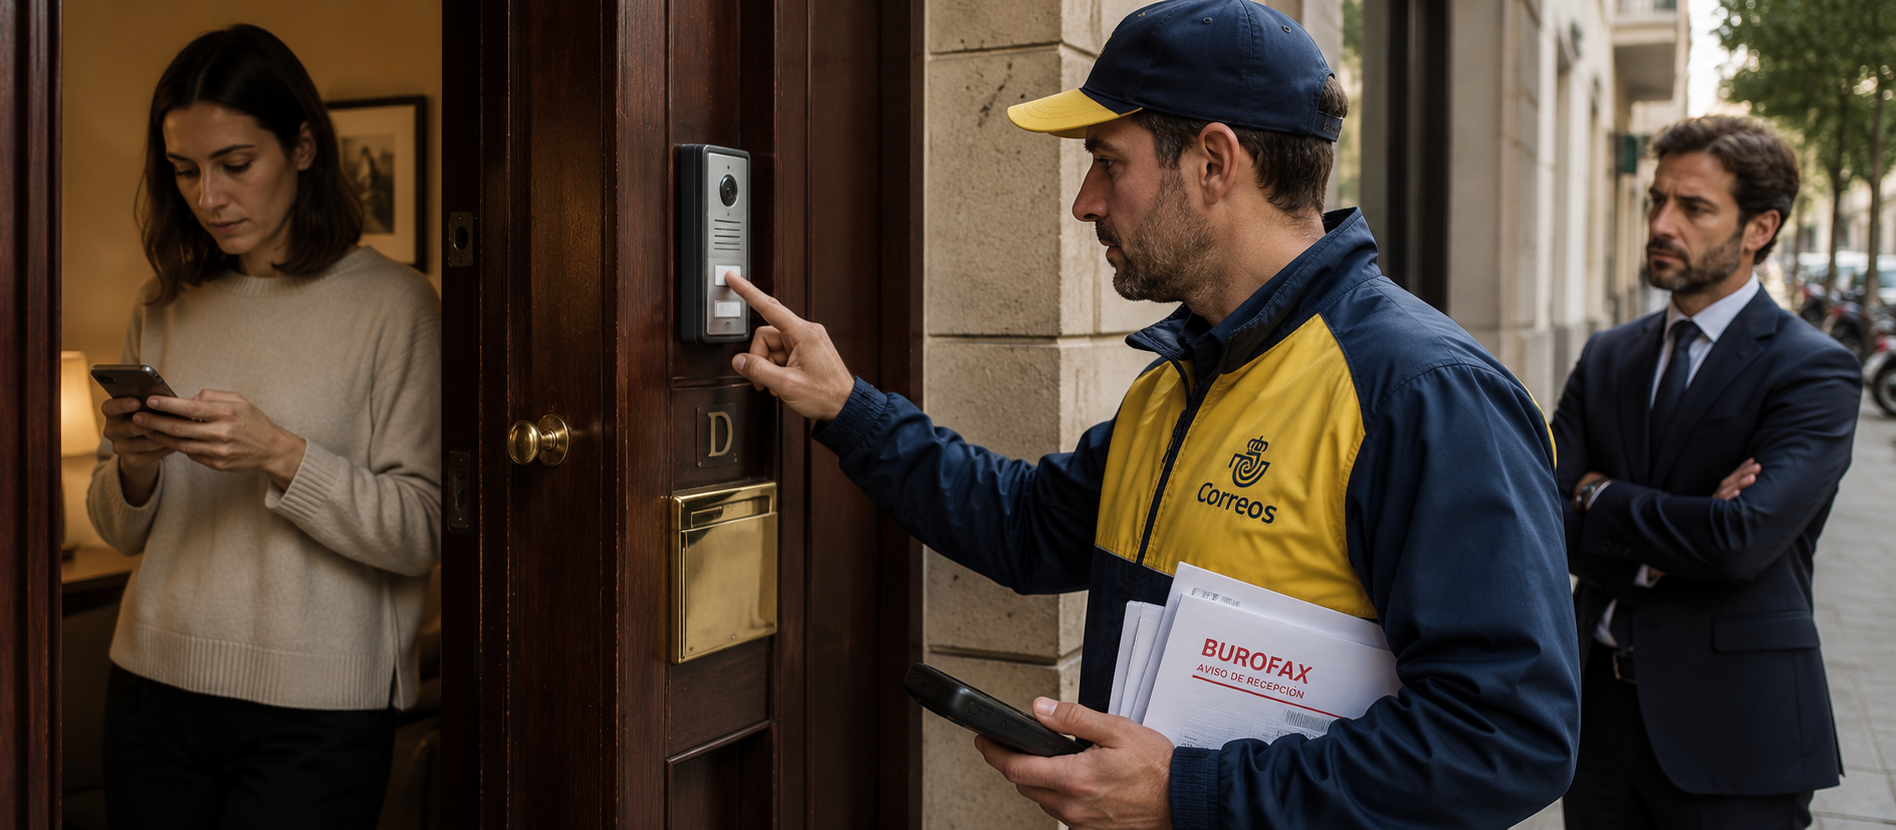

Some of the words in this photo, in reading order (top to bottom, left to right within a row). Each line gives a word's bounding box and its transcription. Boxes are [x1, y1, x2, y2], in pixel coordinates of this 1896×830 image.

[707, 411, 733, 457] D
[1197, 482, 1278, 524] Correos
[1196, 663, 1228, 679] AVISO
[1230, 671, 1245, 683] DE
[1246, 676, 1305, 699] RECEPCIÓN
[1201, 638, 1313, 685] BUROFAX
